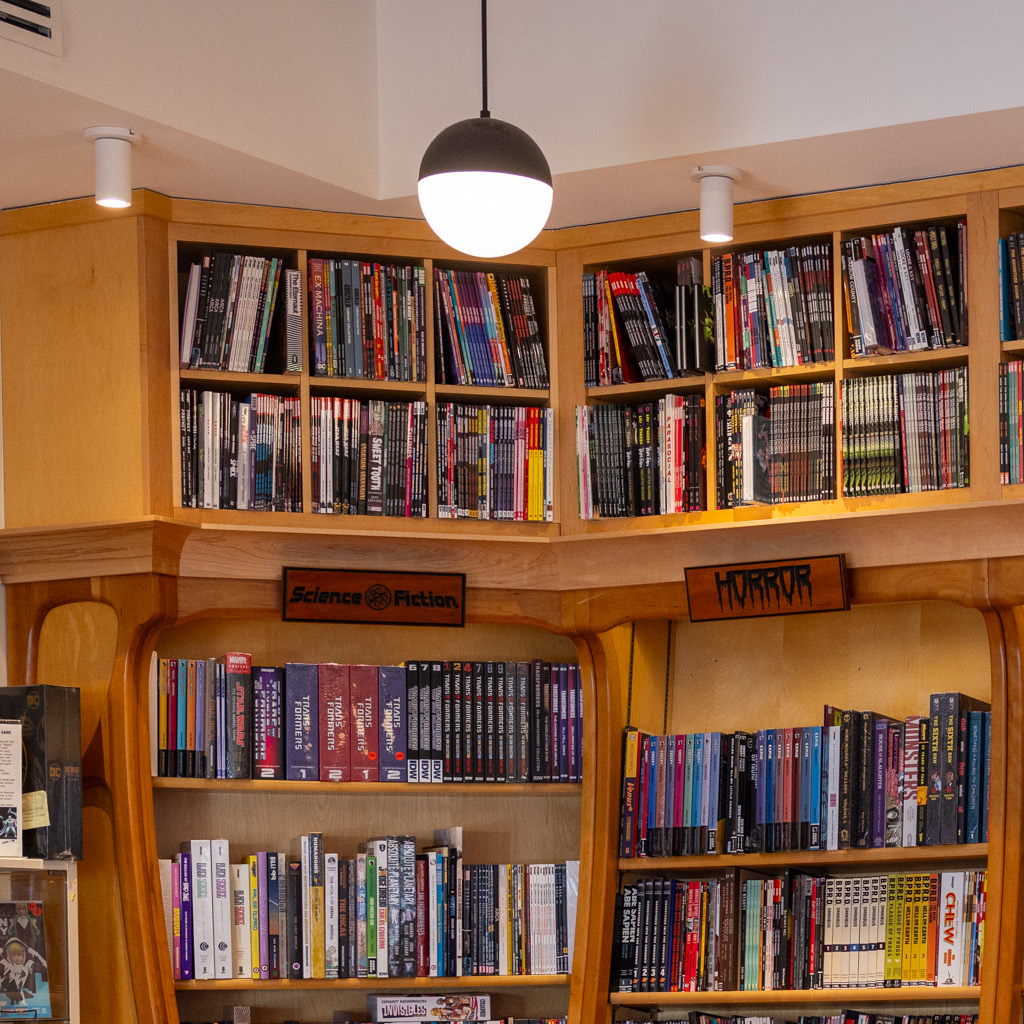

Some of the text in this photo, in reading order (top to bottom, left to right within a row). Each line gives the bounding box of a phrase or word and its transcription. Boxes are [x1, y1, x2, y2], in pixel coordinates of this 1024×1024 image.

[370, 437, 382, 491] SWEET TOOTH
[290, 586, 459, 609] Science Fiction
[716, 564, 813, 613] HORROR
[229, 656, 247, 664] MARVEL
[409, 761, 417, 780] IDW
[622, 910, 631, 943] SAPIEN
[943, 892, 956, 945] CHEW
